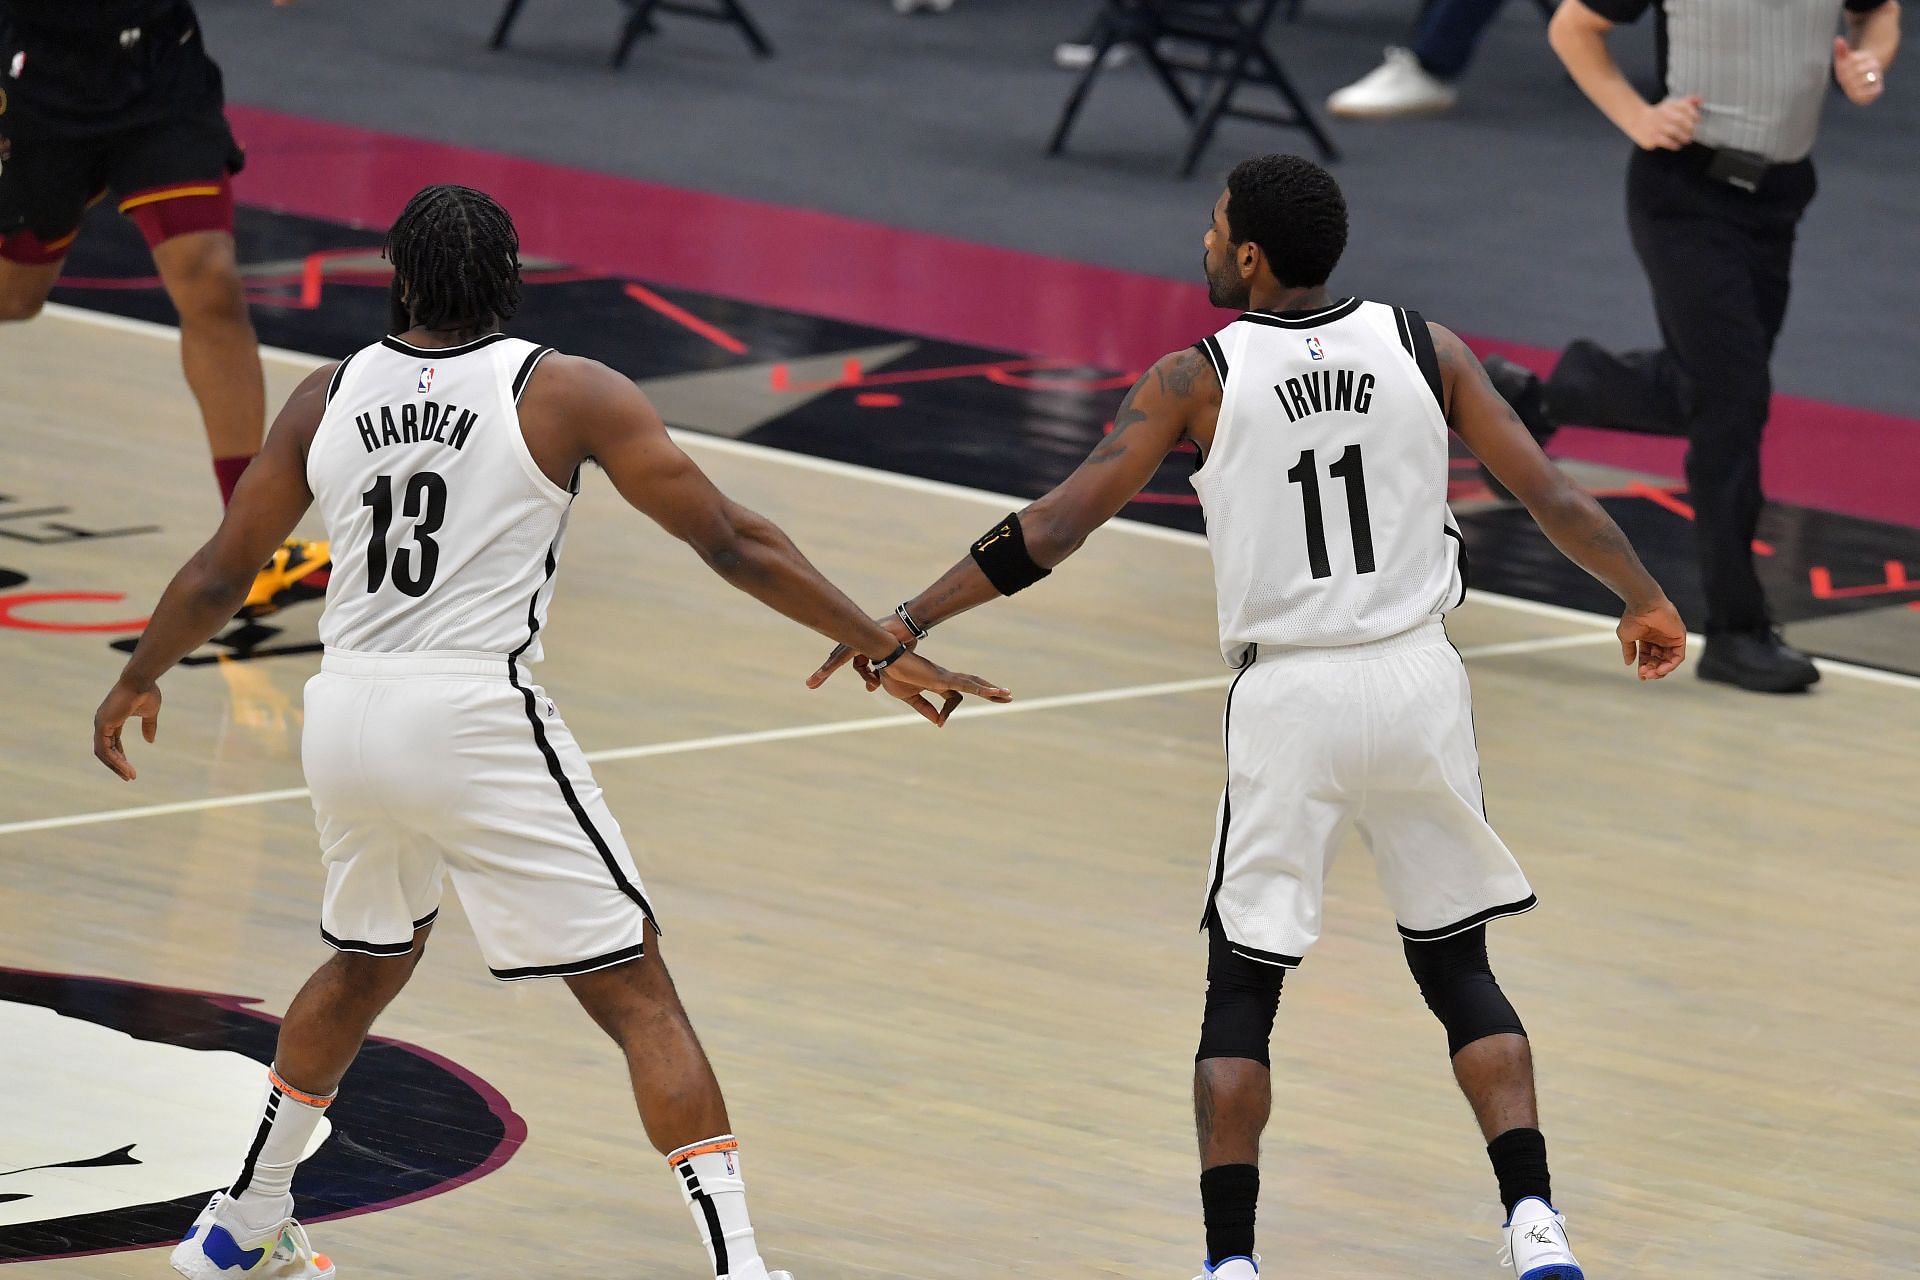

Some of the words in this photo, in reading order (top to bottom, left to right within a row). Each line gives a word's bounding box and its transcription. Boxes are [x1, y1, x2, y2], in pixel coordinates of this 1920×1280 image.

[355, 401, 479, 453] HARDEN
[1274, 369, 1375, 423] IRVING
[362, 472, 447, 597] 13
[1288, 444, 1375, 579] 11
